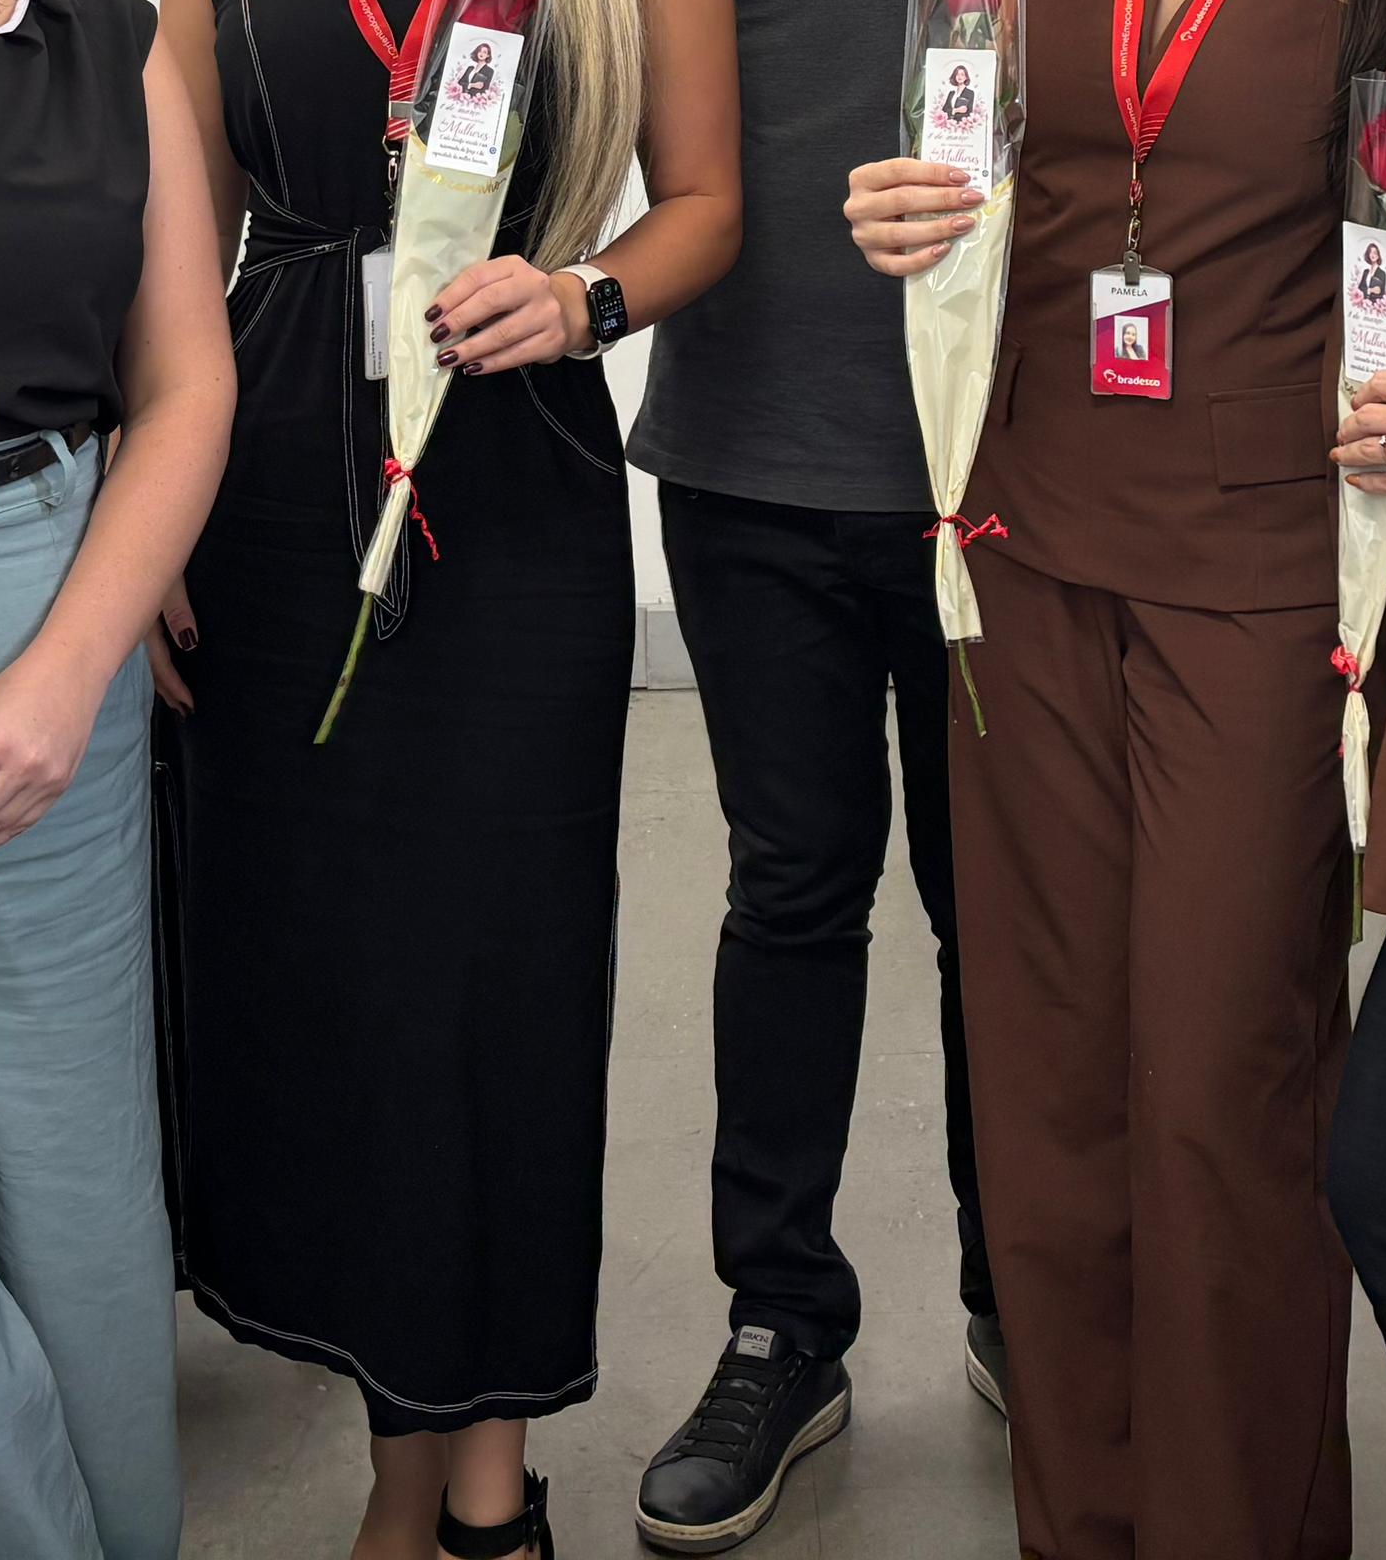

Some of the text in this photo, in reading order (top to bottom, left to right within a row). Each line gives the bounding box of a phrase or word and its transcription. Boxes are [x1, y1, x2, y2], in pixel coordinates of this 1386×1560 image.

[1189, 0, 1213, 32] bradesco
[1111, 287, 1148, 297] PAMELA
[1117, 375, 1161, 387] bradesco
